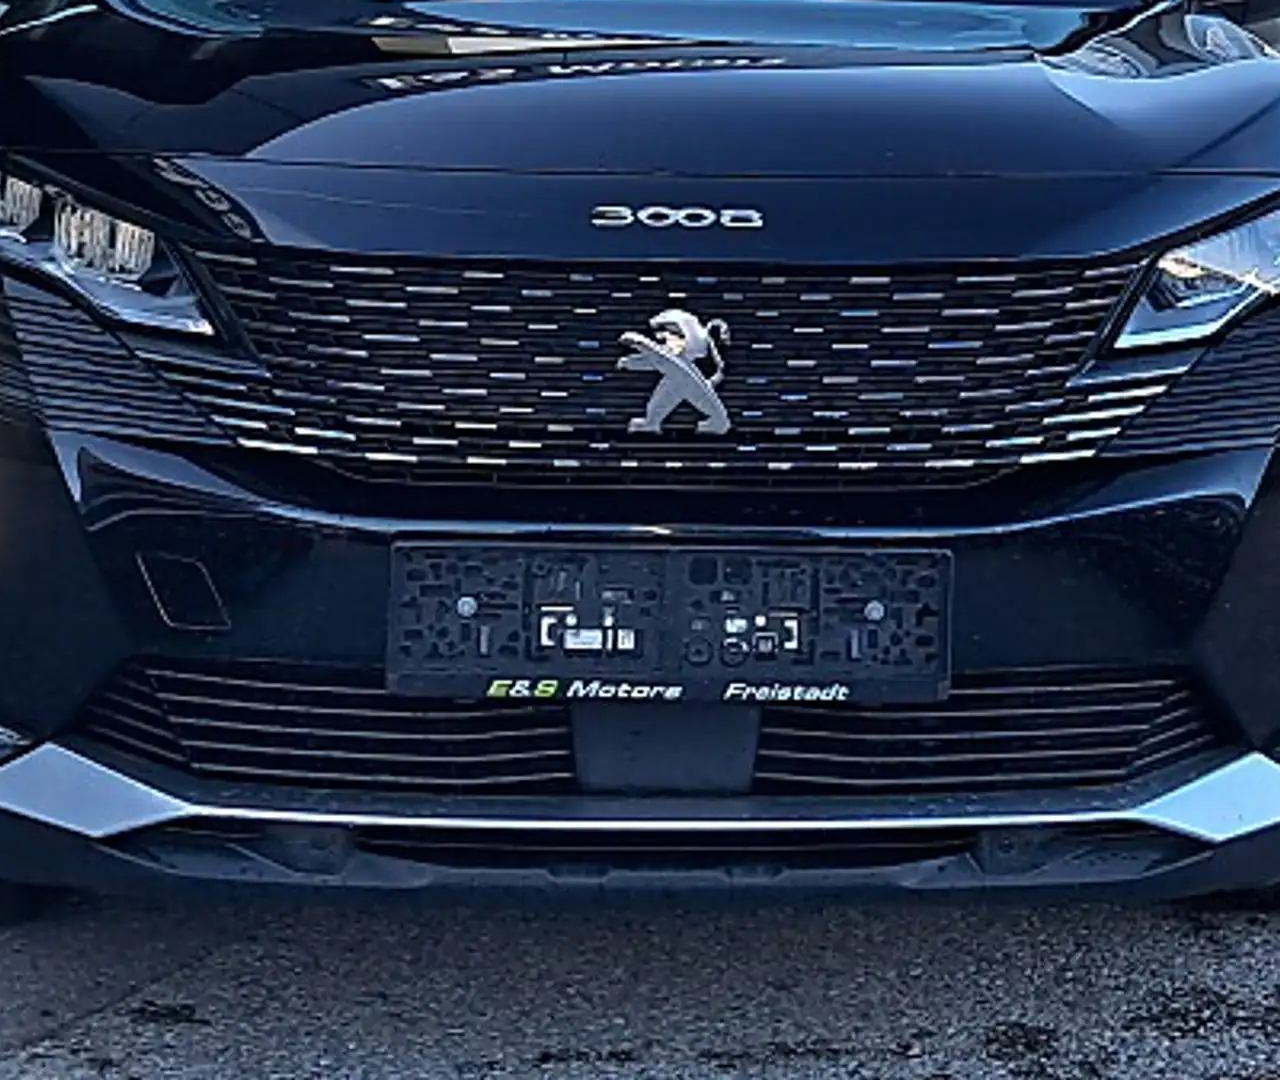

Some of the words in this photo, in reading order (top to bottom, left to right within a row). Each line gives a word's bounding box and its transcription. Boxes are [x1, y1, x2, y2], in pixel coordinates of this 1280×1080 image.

[591, 205, 764, 228] 3008
[486, 678, 560, 699] E&S
[566, 678, 684, 700] Motors
[723, 681, 851, 702] Freistadt
